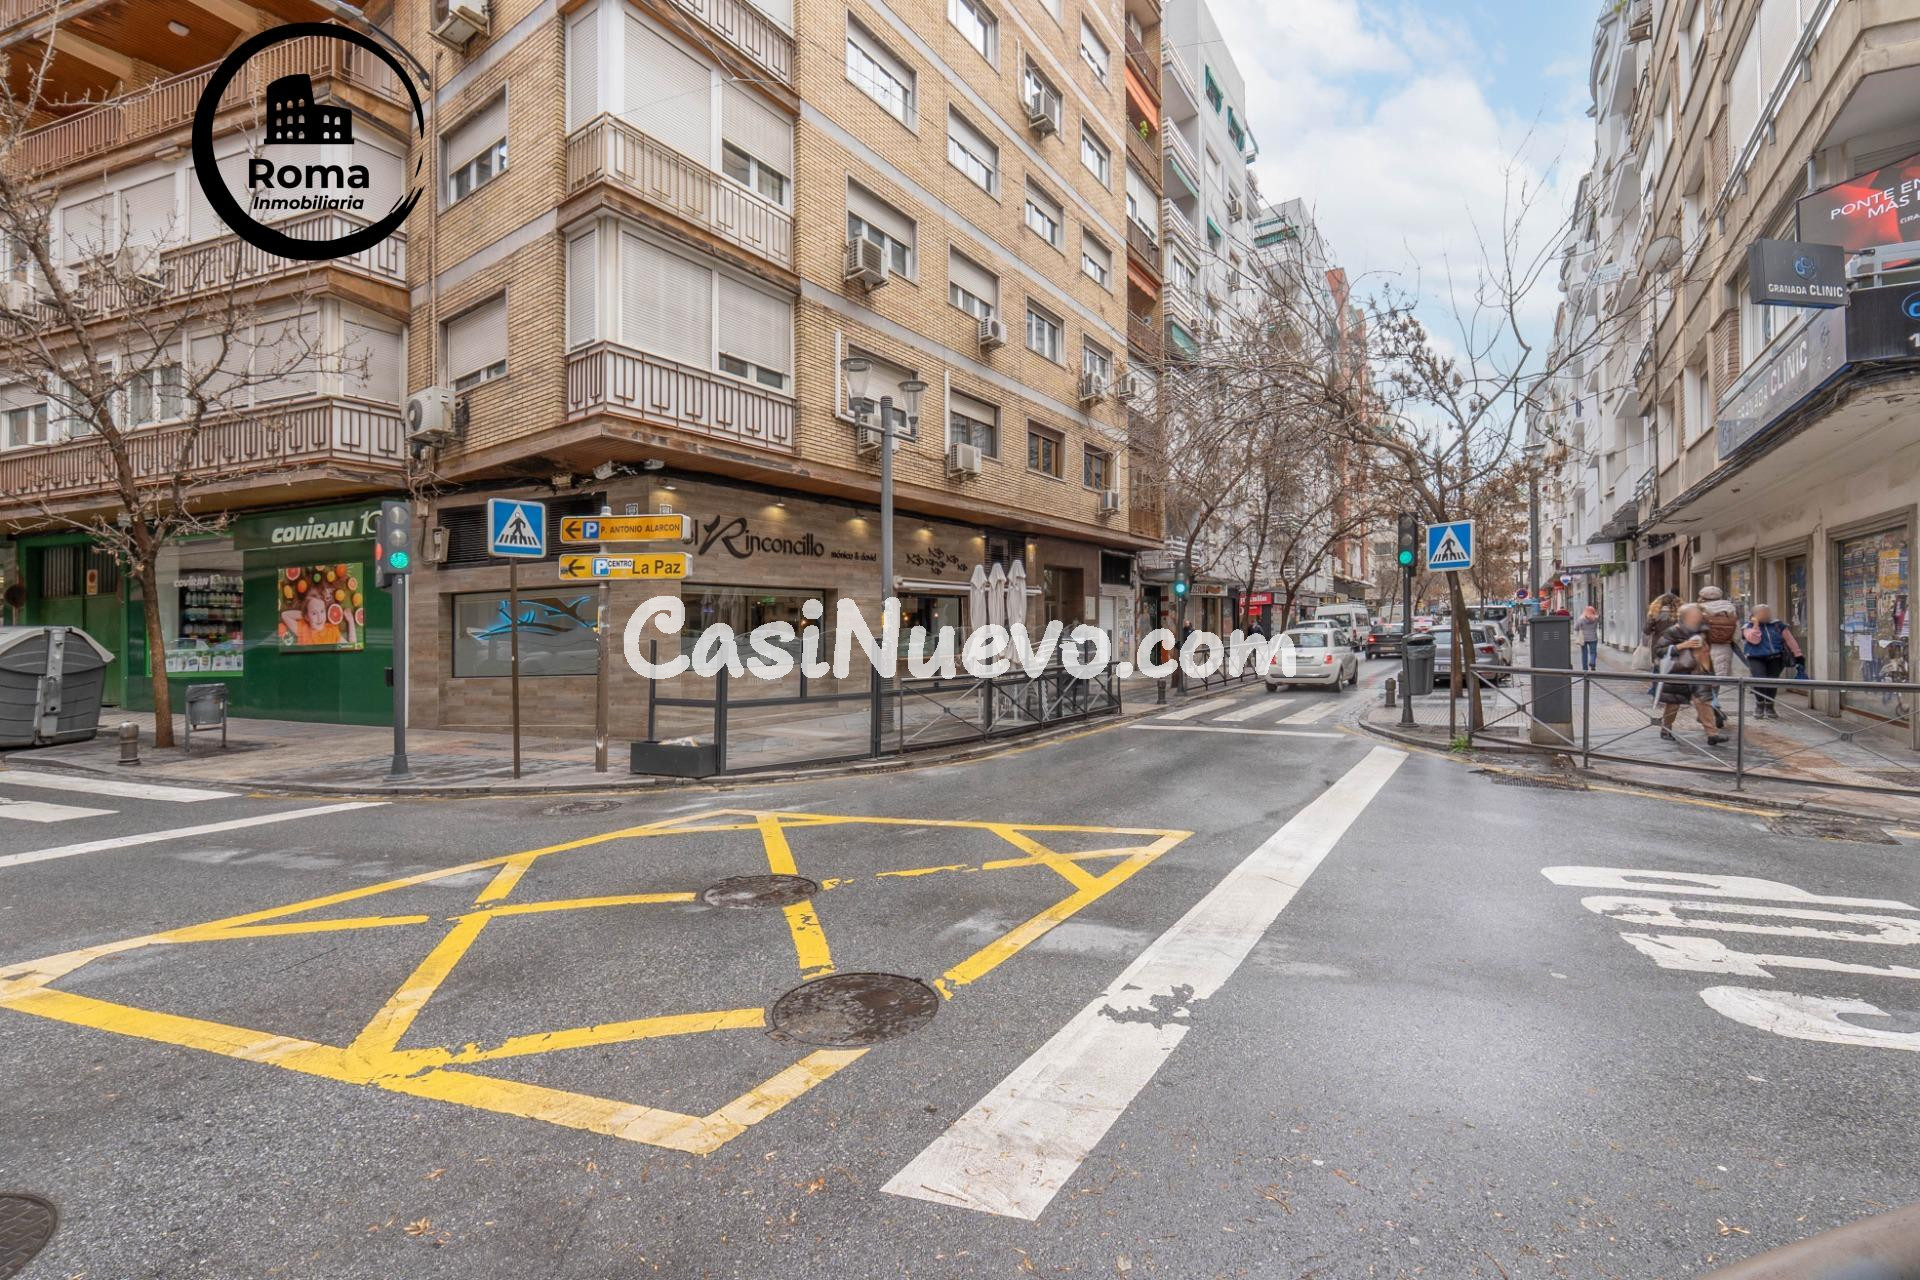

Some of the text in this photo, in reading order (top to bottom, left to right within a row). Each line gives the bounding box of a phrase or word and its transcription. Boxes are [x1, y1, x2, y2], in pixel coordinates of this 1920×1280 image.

[1830, 187, 1895, 221] PONTE
[1868, 194, 1910, 219] MÁS
[1768, 283, 1844, 298] GRANADA CLINIC
[1770, 340, 1808, 397] CLINIC
[610, 525, 642, 534] ANTONIO
[645, 523, 680, 533] ALARCON
[699, 515, 825, 559] Rinconcillo
[608, 560, 632, 568] CENTRO
[632, 560, 649, 574] La
[654, 560, 681, 574] Paz
